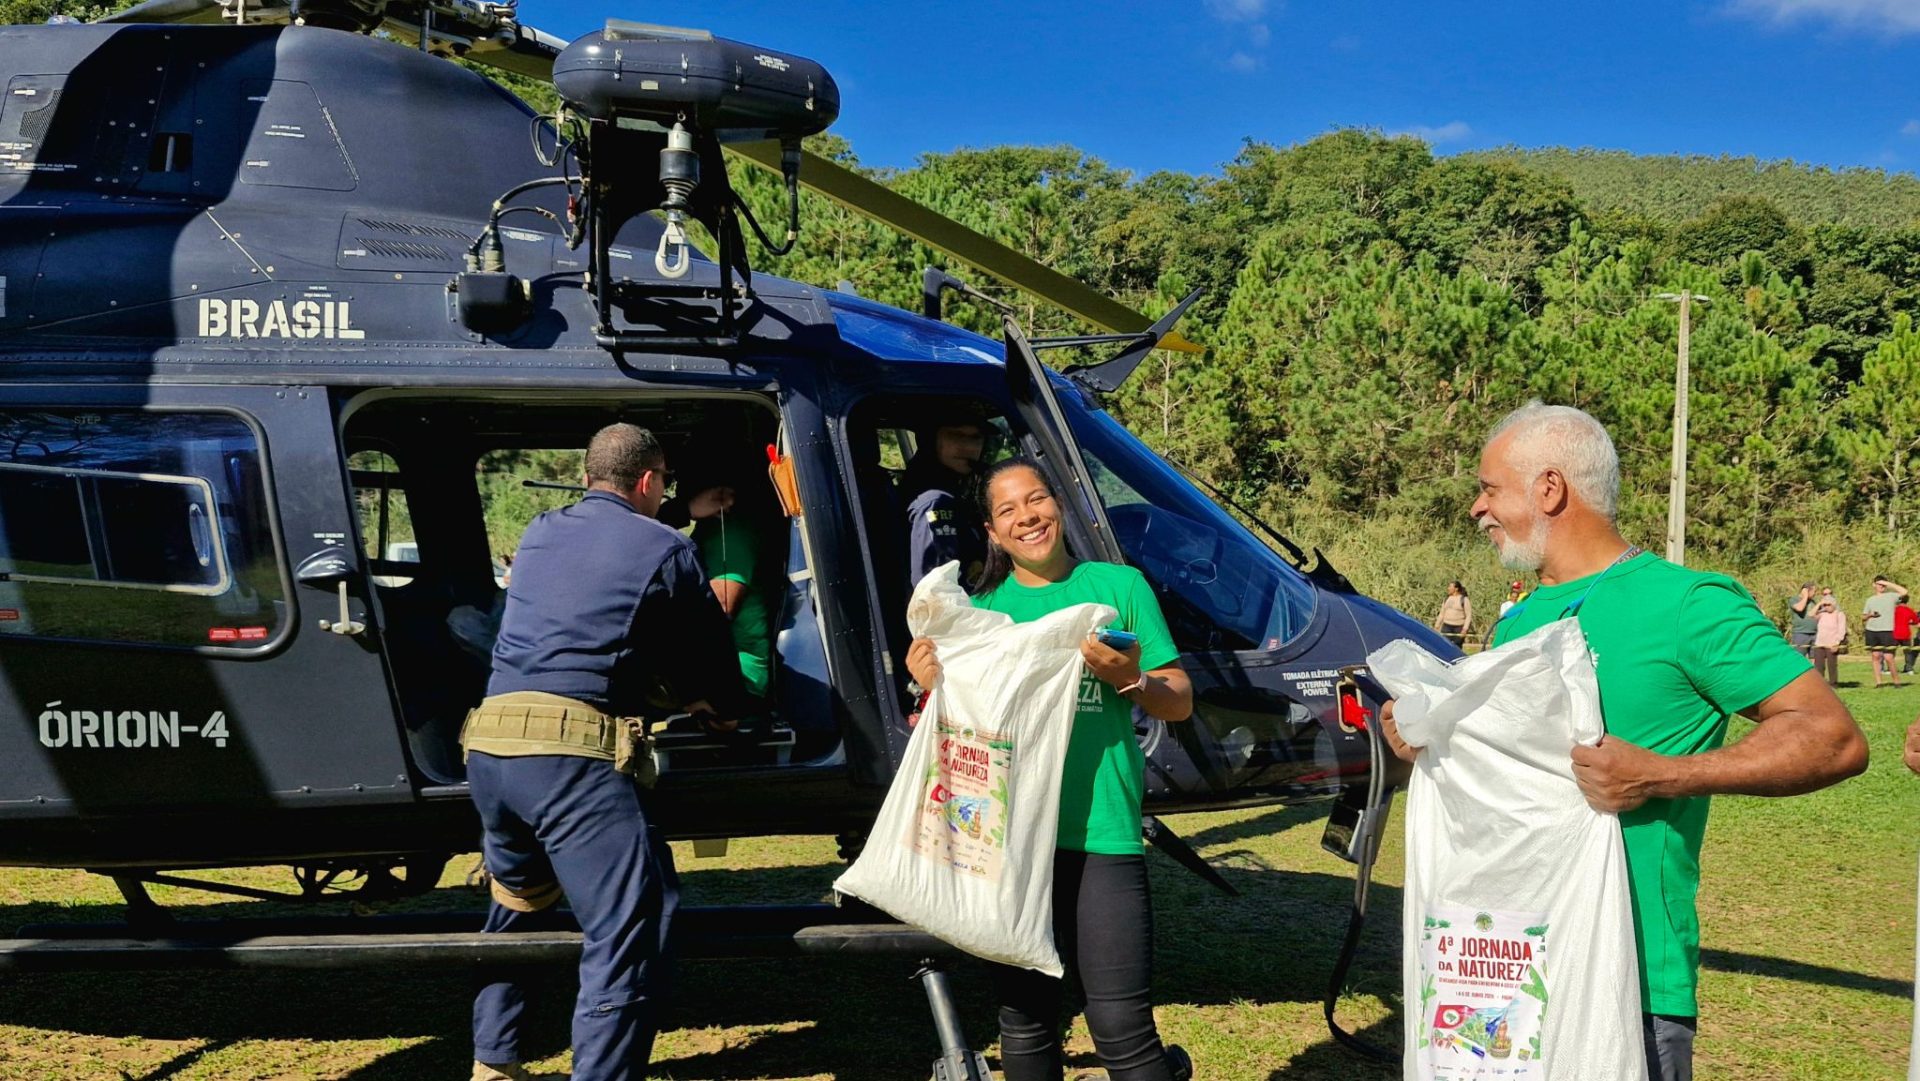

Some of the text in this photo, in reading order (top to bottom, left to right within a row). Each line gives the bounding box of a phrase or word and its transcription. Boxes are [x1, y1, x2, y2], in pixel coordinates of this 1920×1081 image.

[199, 299, 365, 339] BRASIL
[1282, 671, 1310, 680] TOMADA
[1311, 669, 1339, 679] ELÉTRICA
[1296, 680, 1333, 690] EXTERNAL
[1303, 688, 1329, 697] POWER
[38, 700, 229, 748] ÓRION-4
[1438, 936, 1532, 961] 4ª JORNADA
[1438, 961, 1453, 972] DA
